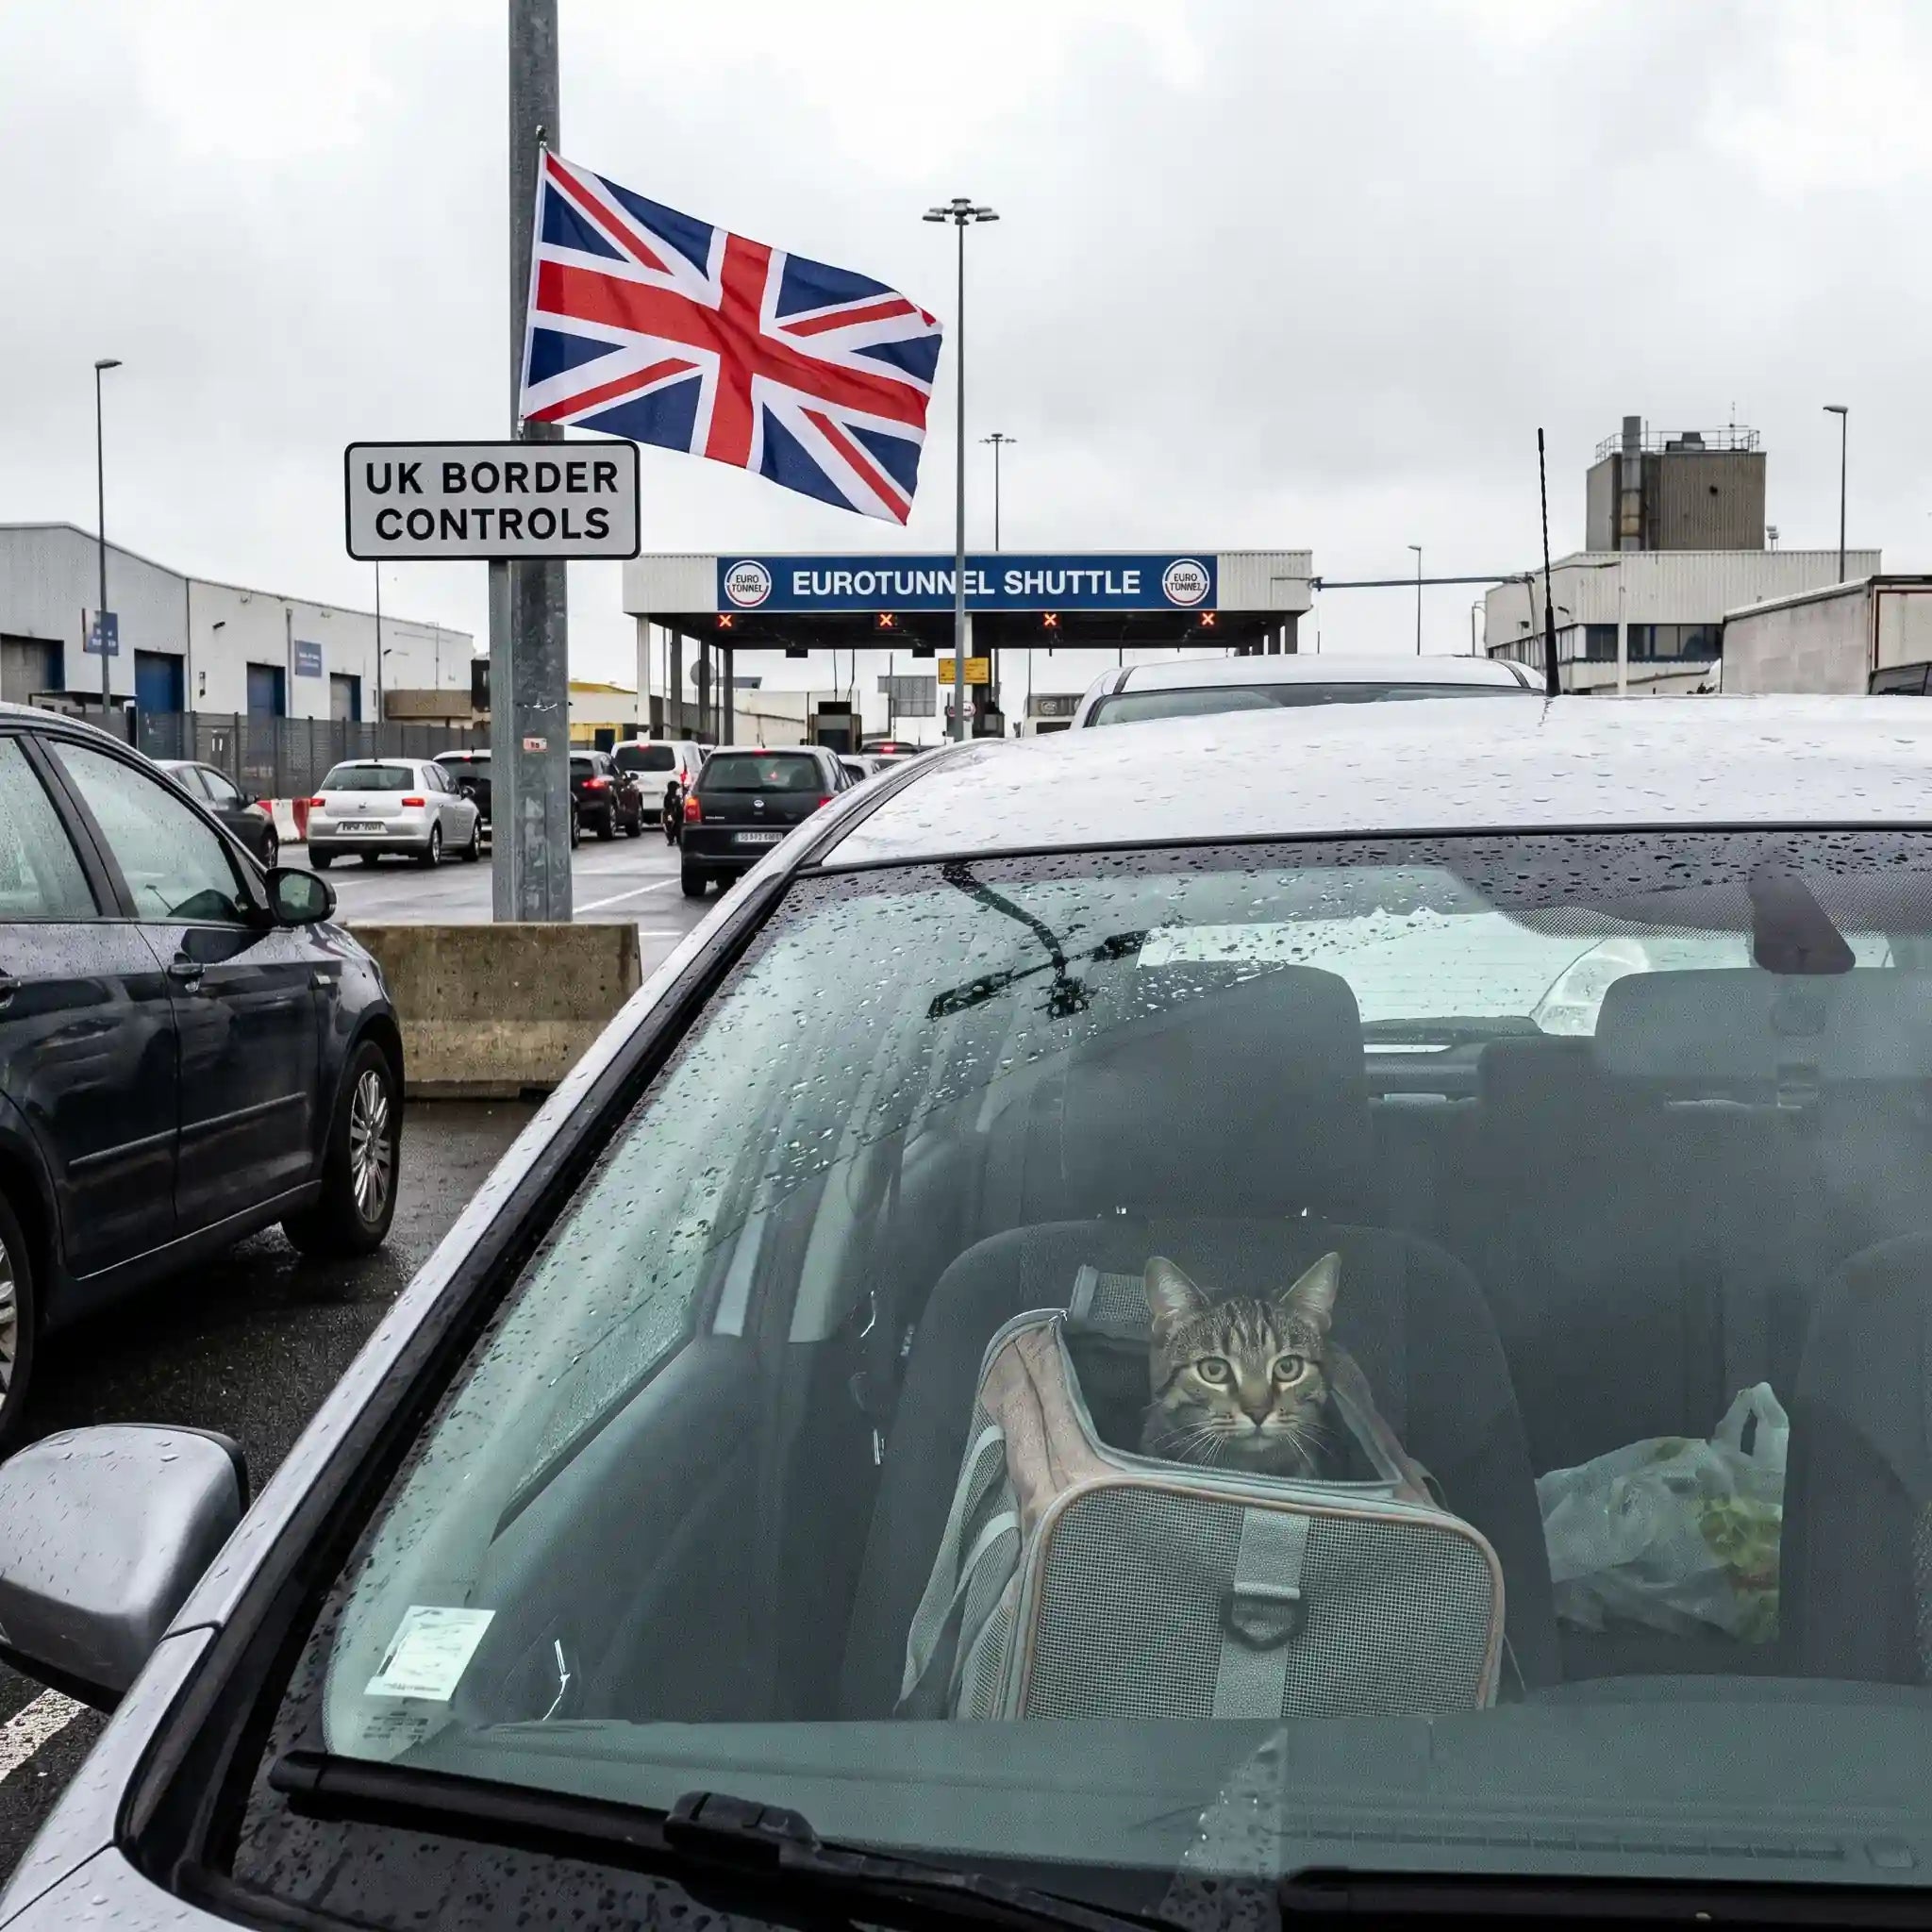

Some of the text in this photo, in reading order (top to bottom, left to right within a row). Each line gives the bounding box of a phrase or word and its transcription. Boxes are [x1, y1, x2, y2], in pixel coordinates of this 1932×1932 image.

[366, 461, 619, 494] UK BORDER
[375, 508, 610, 541] CONTROLS
[736, 575, 759, 583] EURO
[792, 570, 1141, 595] EUROTUNNEL SHUTTLE
[1174, 573, 1198, 582] EURO
[732, 584, 763, 592] TUNNEL
